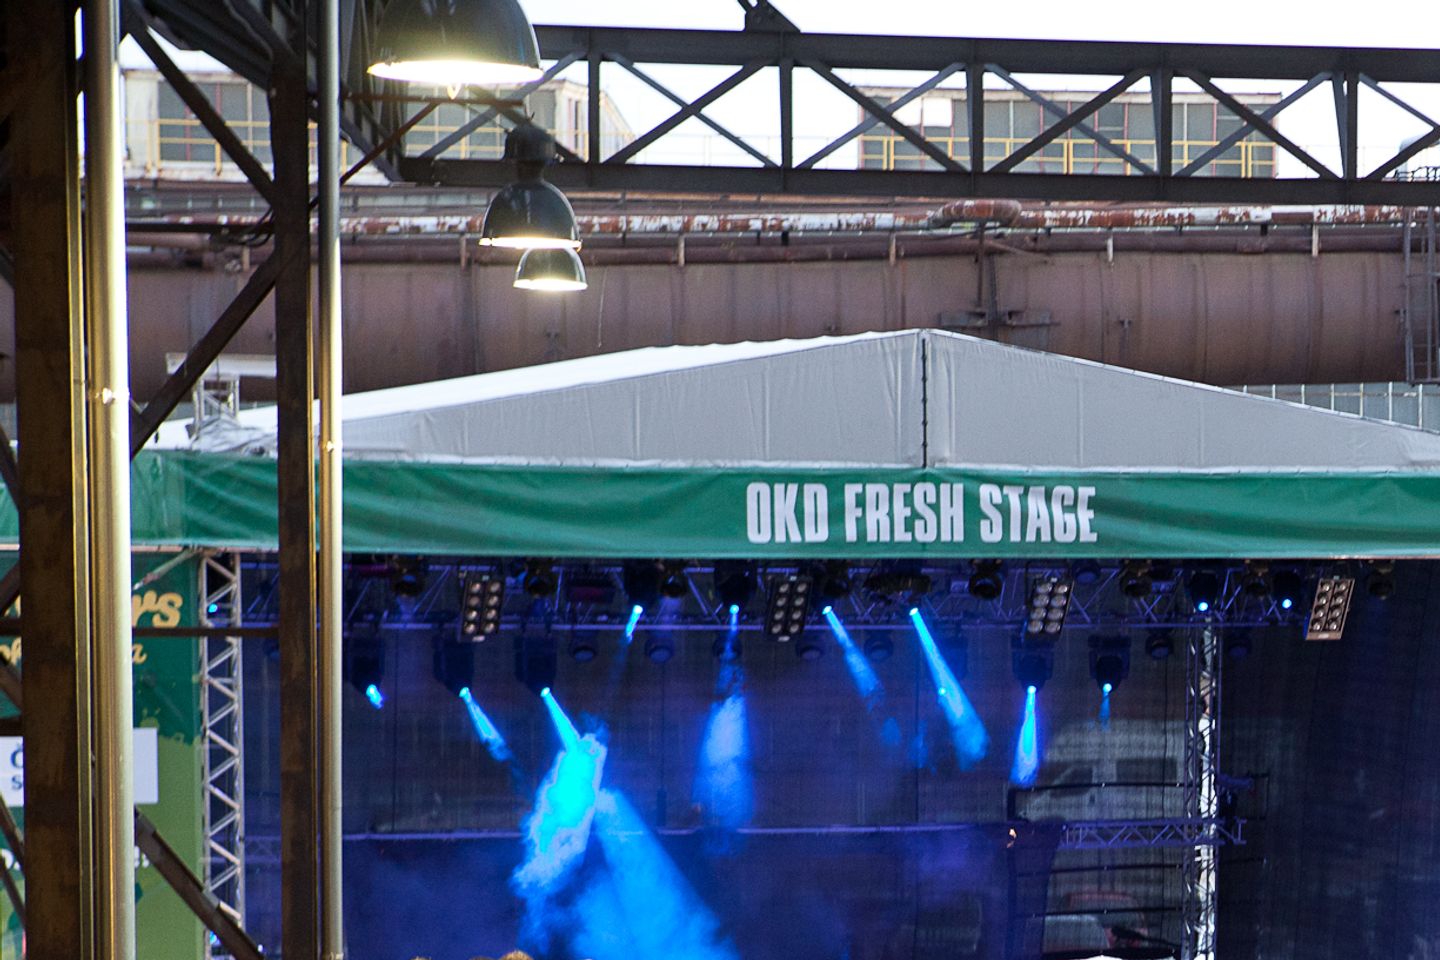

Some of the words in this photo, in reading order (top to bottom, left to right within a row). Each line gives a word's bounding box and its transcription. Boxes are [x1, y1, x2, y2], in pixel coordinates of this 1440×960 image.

[746, 482, 829, 544] OKD
[844, 482, 965, 544] FRESH
[979, 483, 1098, 544] STAGE
